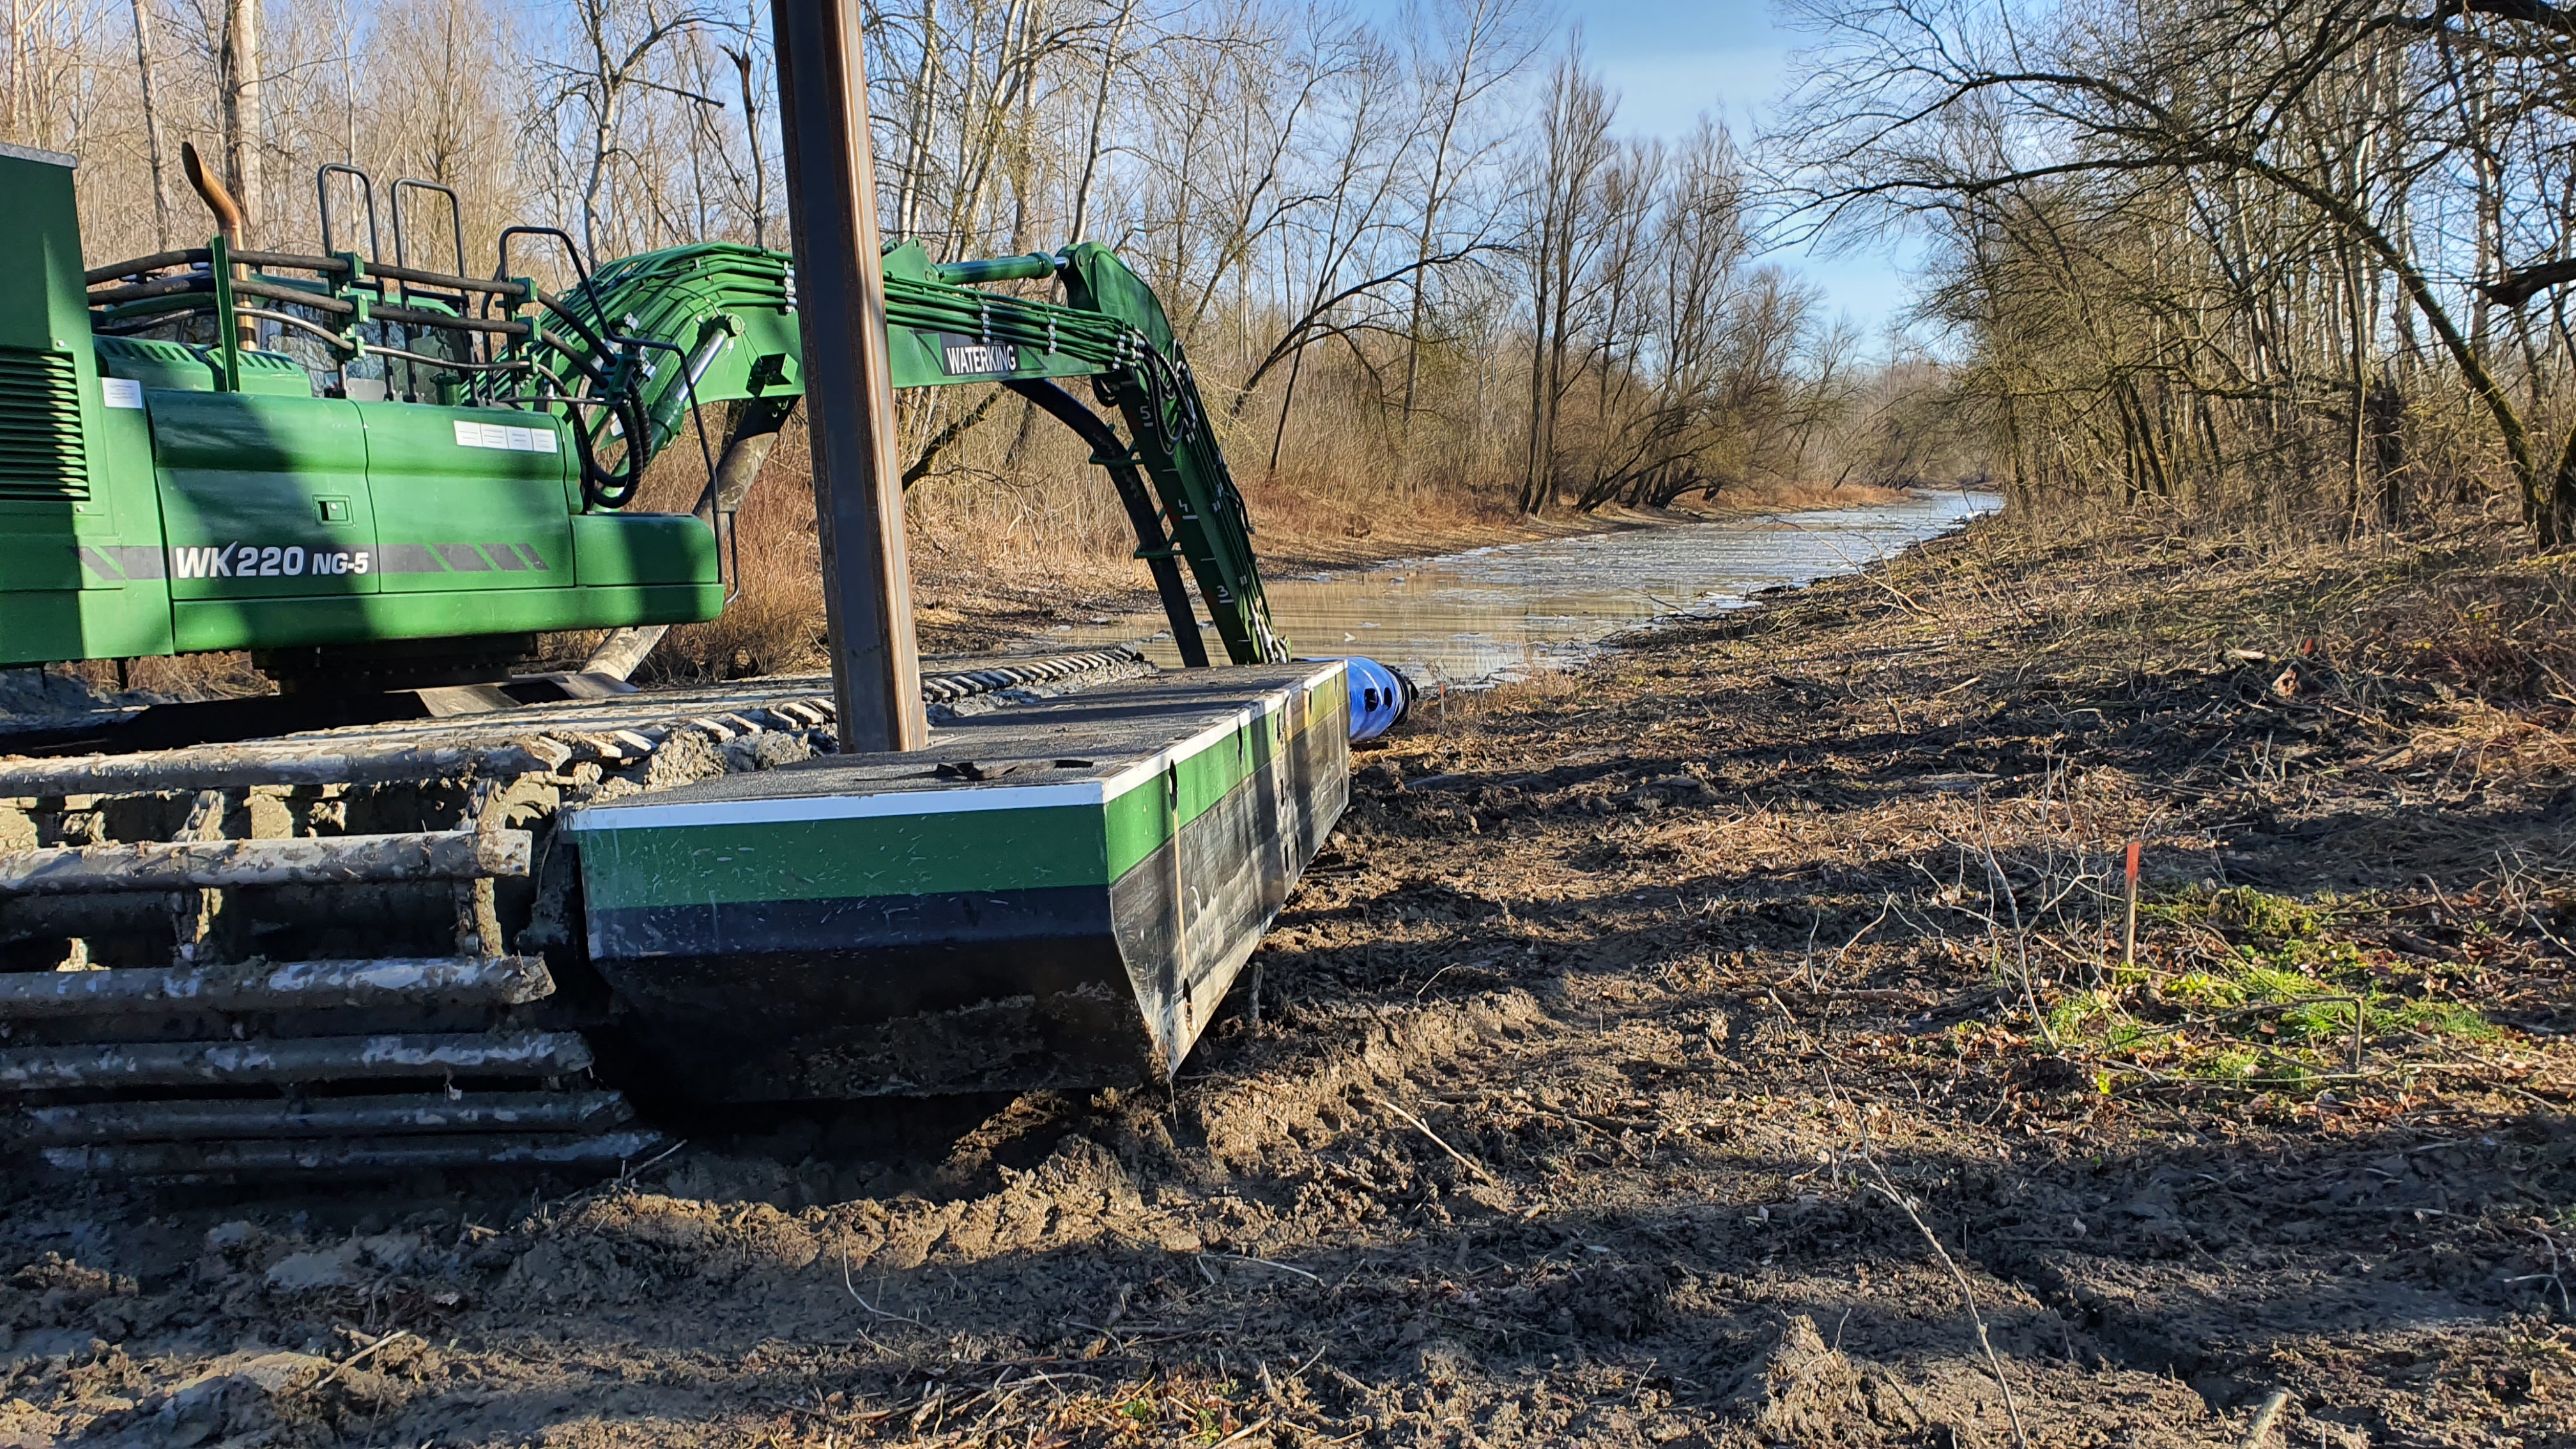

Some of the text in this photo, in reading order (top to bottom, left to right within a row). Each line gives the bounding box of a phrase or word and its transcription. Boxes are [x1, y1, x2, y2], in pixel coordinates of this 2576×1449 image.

[946, 345, 1016, 374] WATERKING
[1140, 405, 1151, 420] 5
[1178, 498, 1188, 513] 4
[176, 540, 369, 578] WK220 NG-5
[1216, 585, 1229, 597] 3
